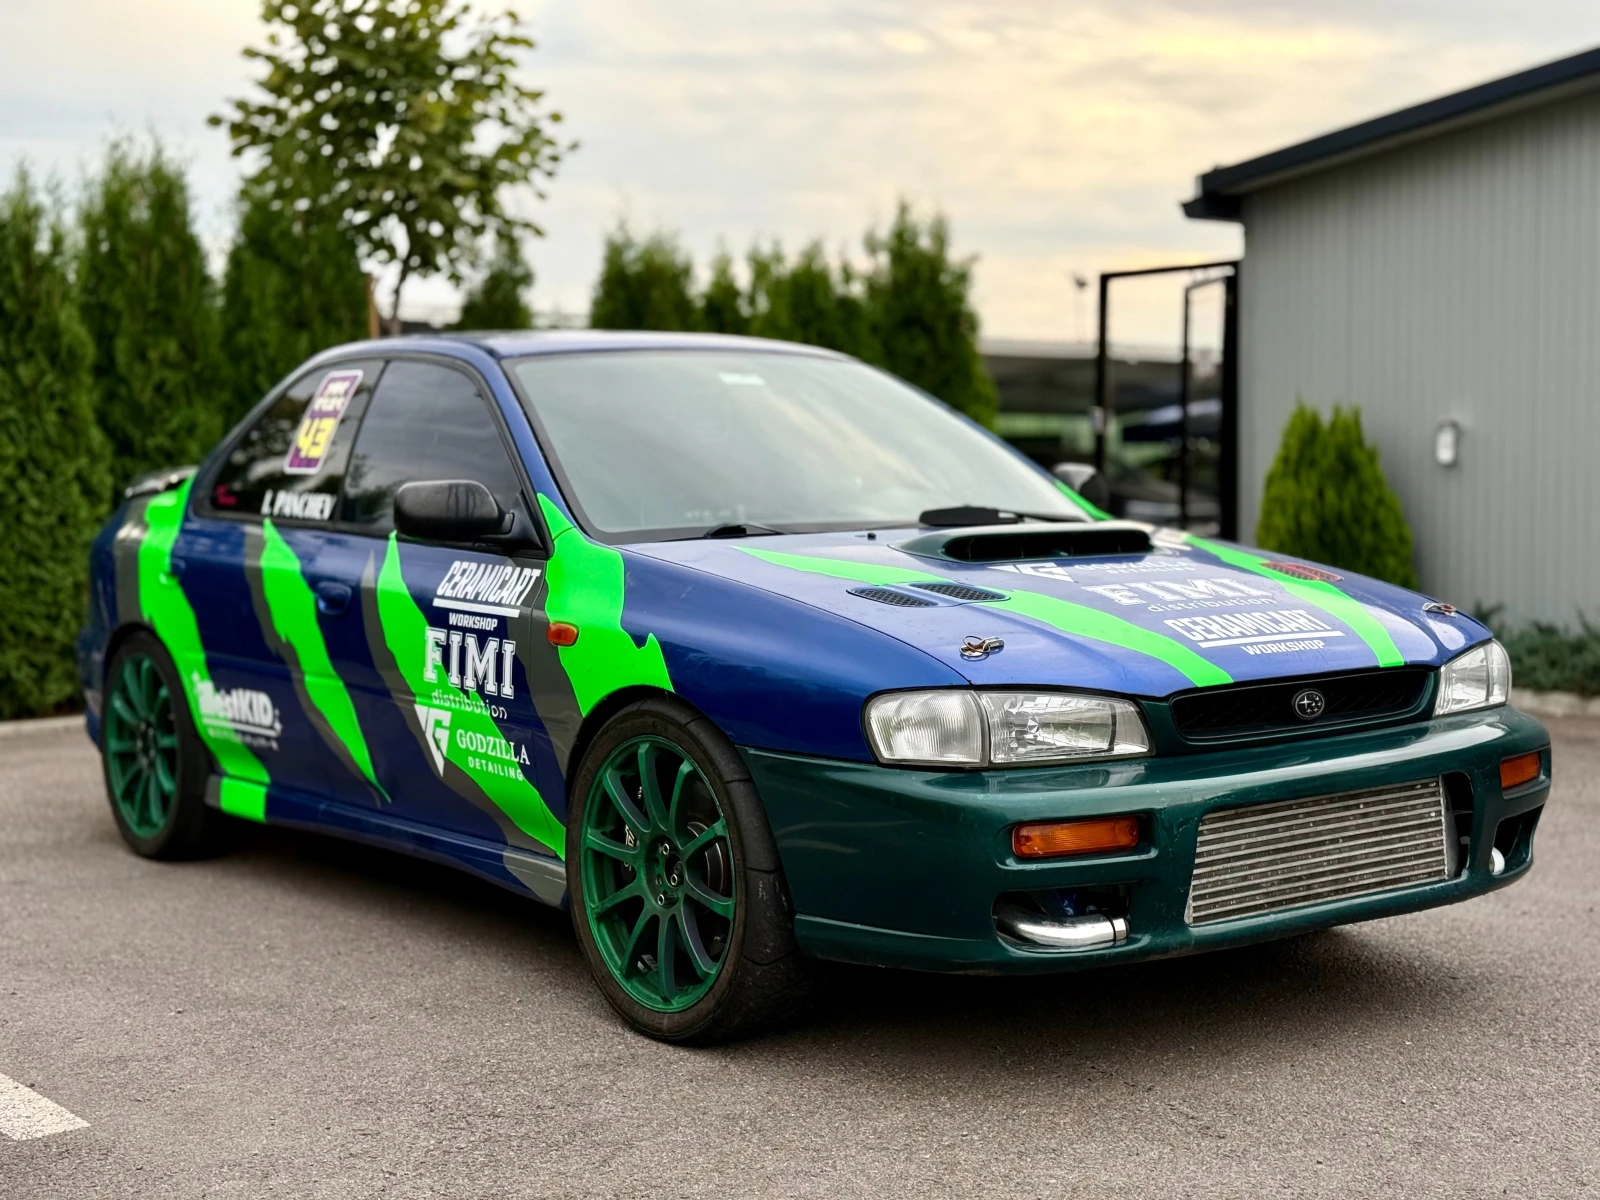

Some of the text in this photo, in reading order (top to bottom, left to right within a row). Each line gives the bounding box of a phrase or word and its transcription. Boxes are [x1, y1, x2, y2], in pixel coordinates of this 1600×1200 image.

[296, 417, 336, 458] 43
[436, 560, 542, 606] CERAMICART
[1080, 578, 1273, 606] FIMI
[1147, 596, 1277, 614] distribution
[449, 612, 498, 631] WORKSHOP
[1163, 609, 1333, 641] CERAMICART
[423, 626, 516, 699] FIMI
[1240, 639, 1325, 655] WORKSHOP
[432, 689, 508, 720] distribution
[456, 729, 531, 765] GODZILLA
[468, 756, 524, 782] DETAILING
